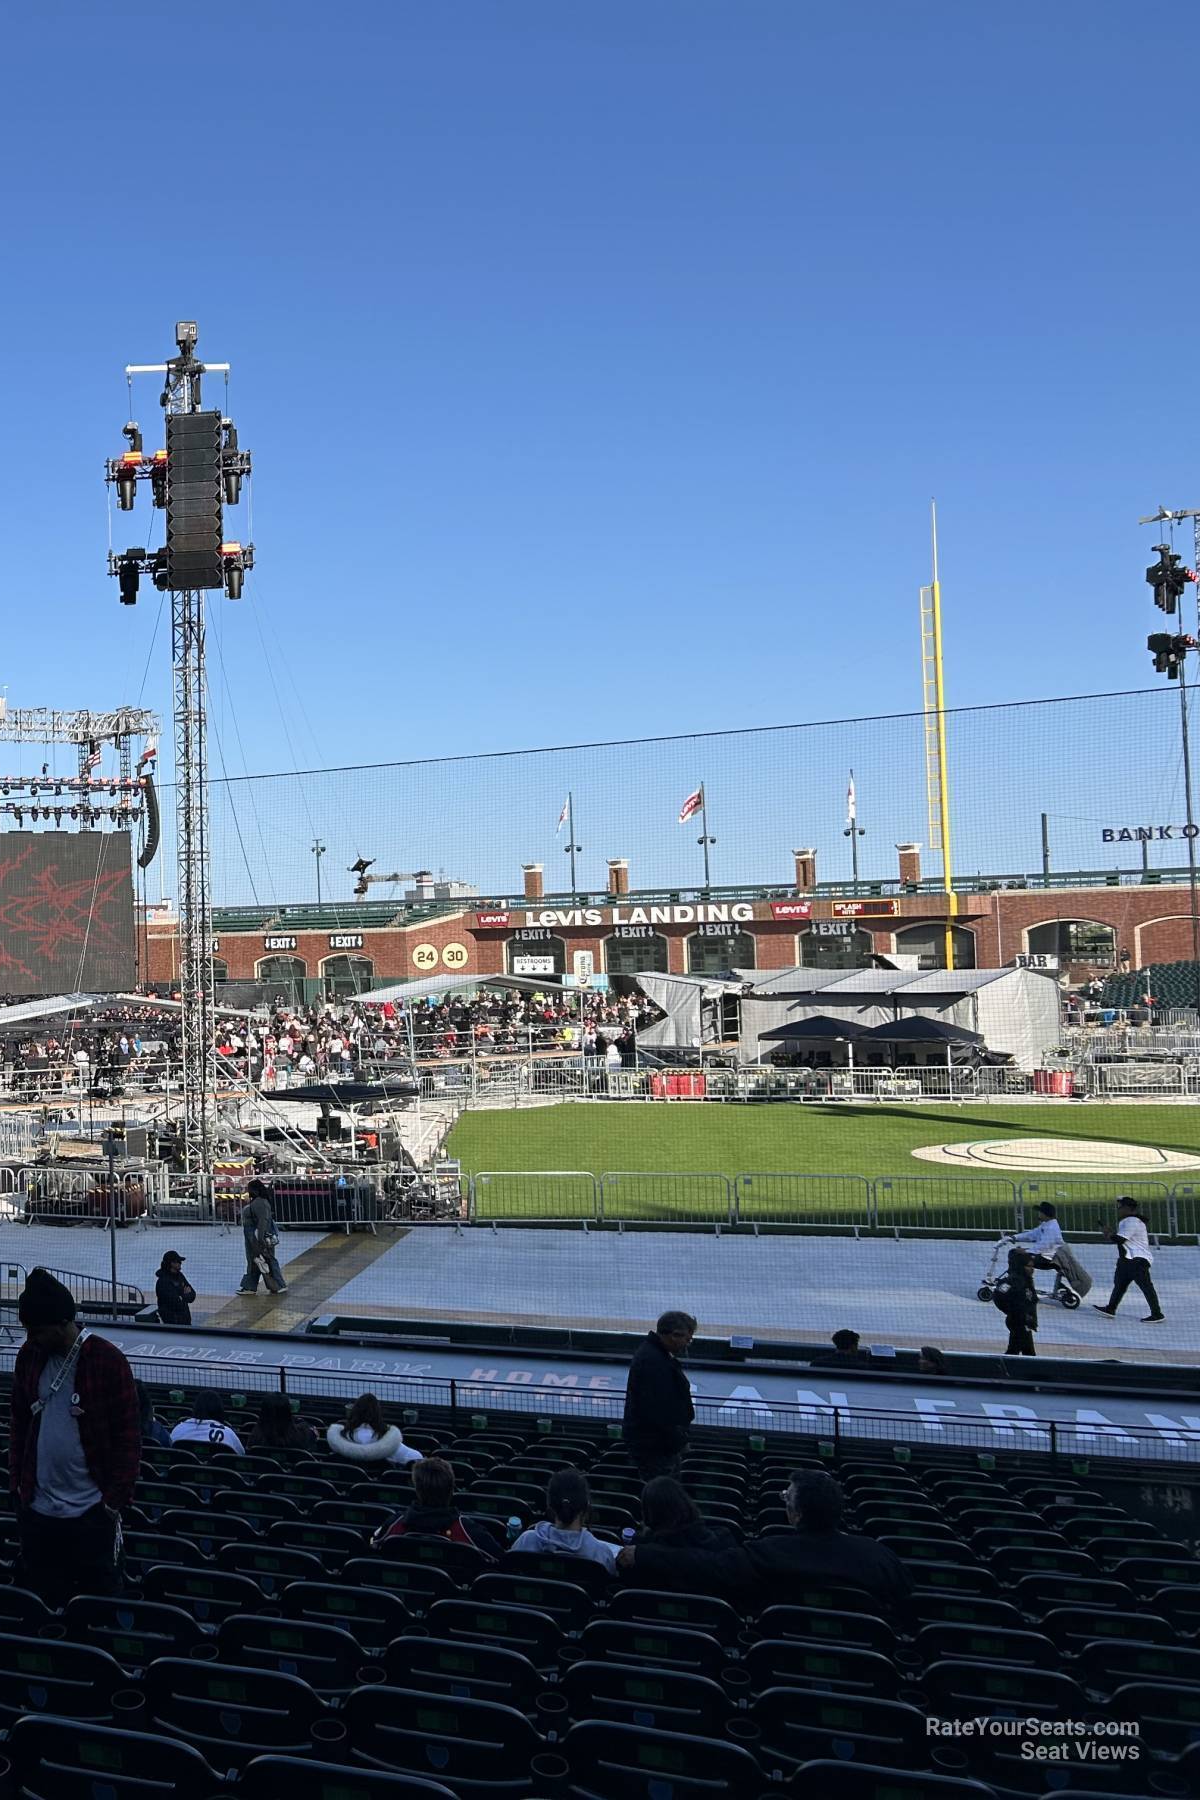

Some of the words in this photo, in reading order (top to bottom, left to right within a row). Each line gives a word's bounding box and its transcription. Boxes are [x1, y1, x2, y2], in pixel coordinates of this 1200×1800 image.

[1101, 825, 1173, 843] BANK
[612, 903, 754, 925] LANDING
[521, 929, 545, 941] EXIT
[621, 926, 647, 938] EXIT
[705, 924, 732, 936] EXIT
[819, 923, 848, 936] EXIT
[271, 937, 290, 949] EXIT
[335, 936, 356, 948] EXIT
[417, 951, 435, 963] 24
[447, 951, 463, 962] 30
[1018, 955, 1048, 968] BAR
[279, 1352, 434, 1383] PARK
[468, 1367, 613, 1391] HOME
[689, 1384, 851, 1424] AN
